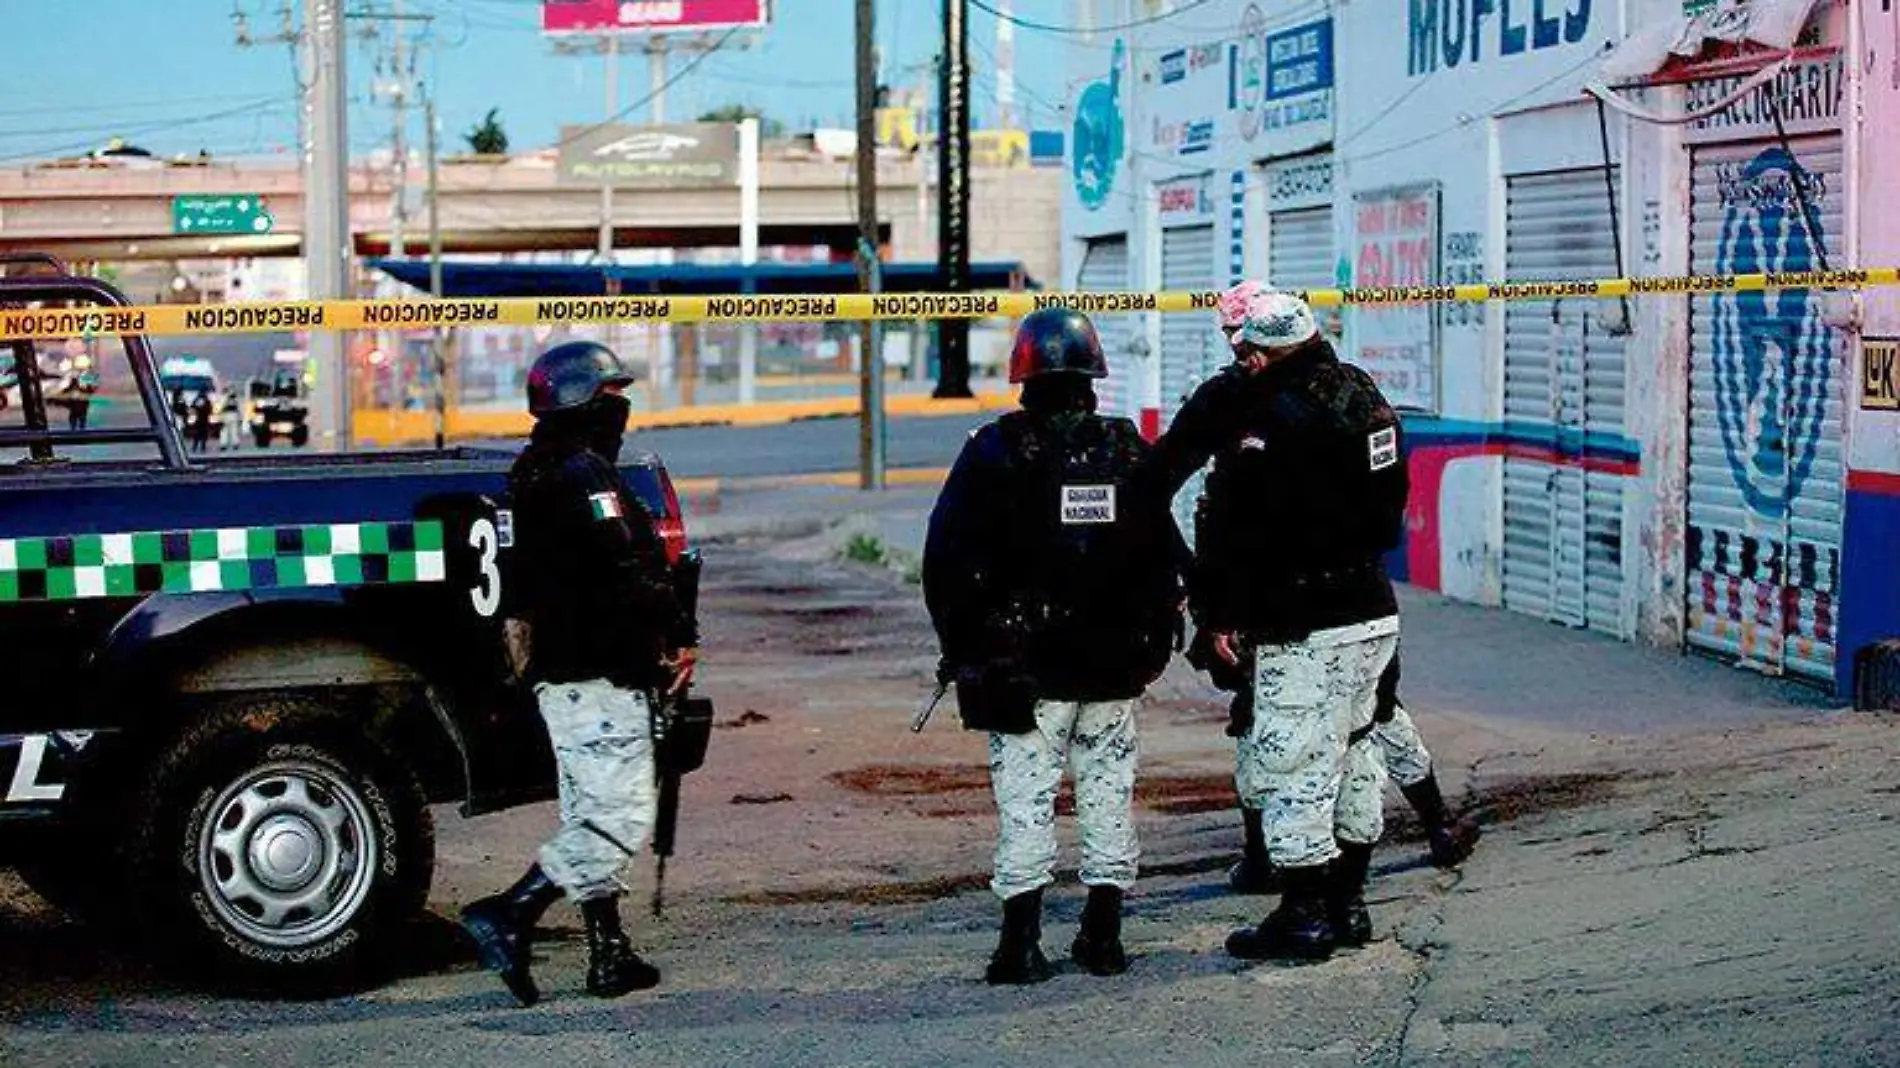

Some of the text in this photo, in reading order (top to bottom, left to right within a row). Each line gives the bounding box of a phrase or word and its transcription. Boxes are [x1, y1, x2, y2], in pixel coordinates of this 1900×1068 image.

[1629, 275, 1735, 291] PRECAUCION
[1034, 294, 1156, 310] PRECAUCION
[1343, 288, 1455, 302] PRECAUCION
[363, 303, 499, 322] PRECAUCION
[537, 300, 670, 318] PRECAUCION
[707, 298, 836, 316] PRECAUCION
[873, 296, 998, 314] PRECAUCION
[5, 311, 145, 334] PRECAUCION
[186, 306, 323, 329] PRECAUCION
[469, 519, 500, 616] 3
